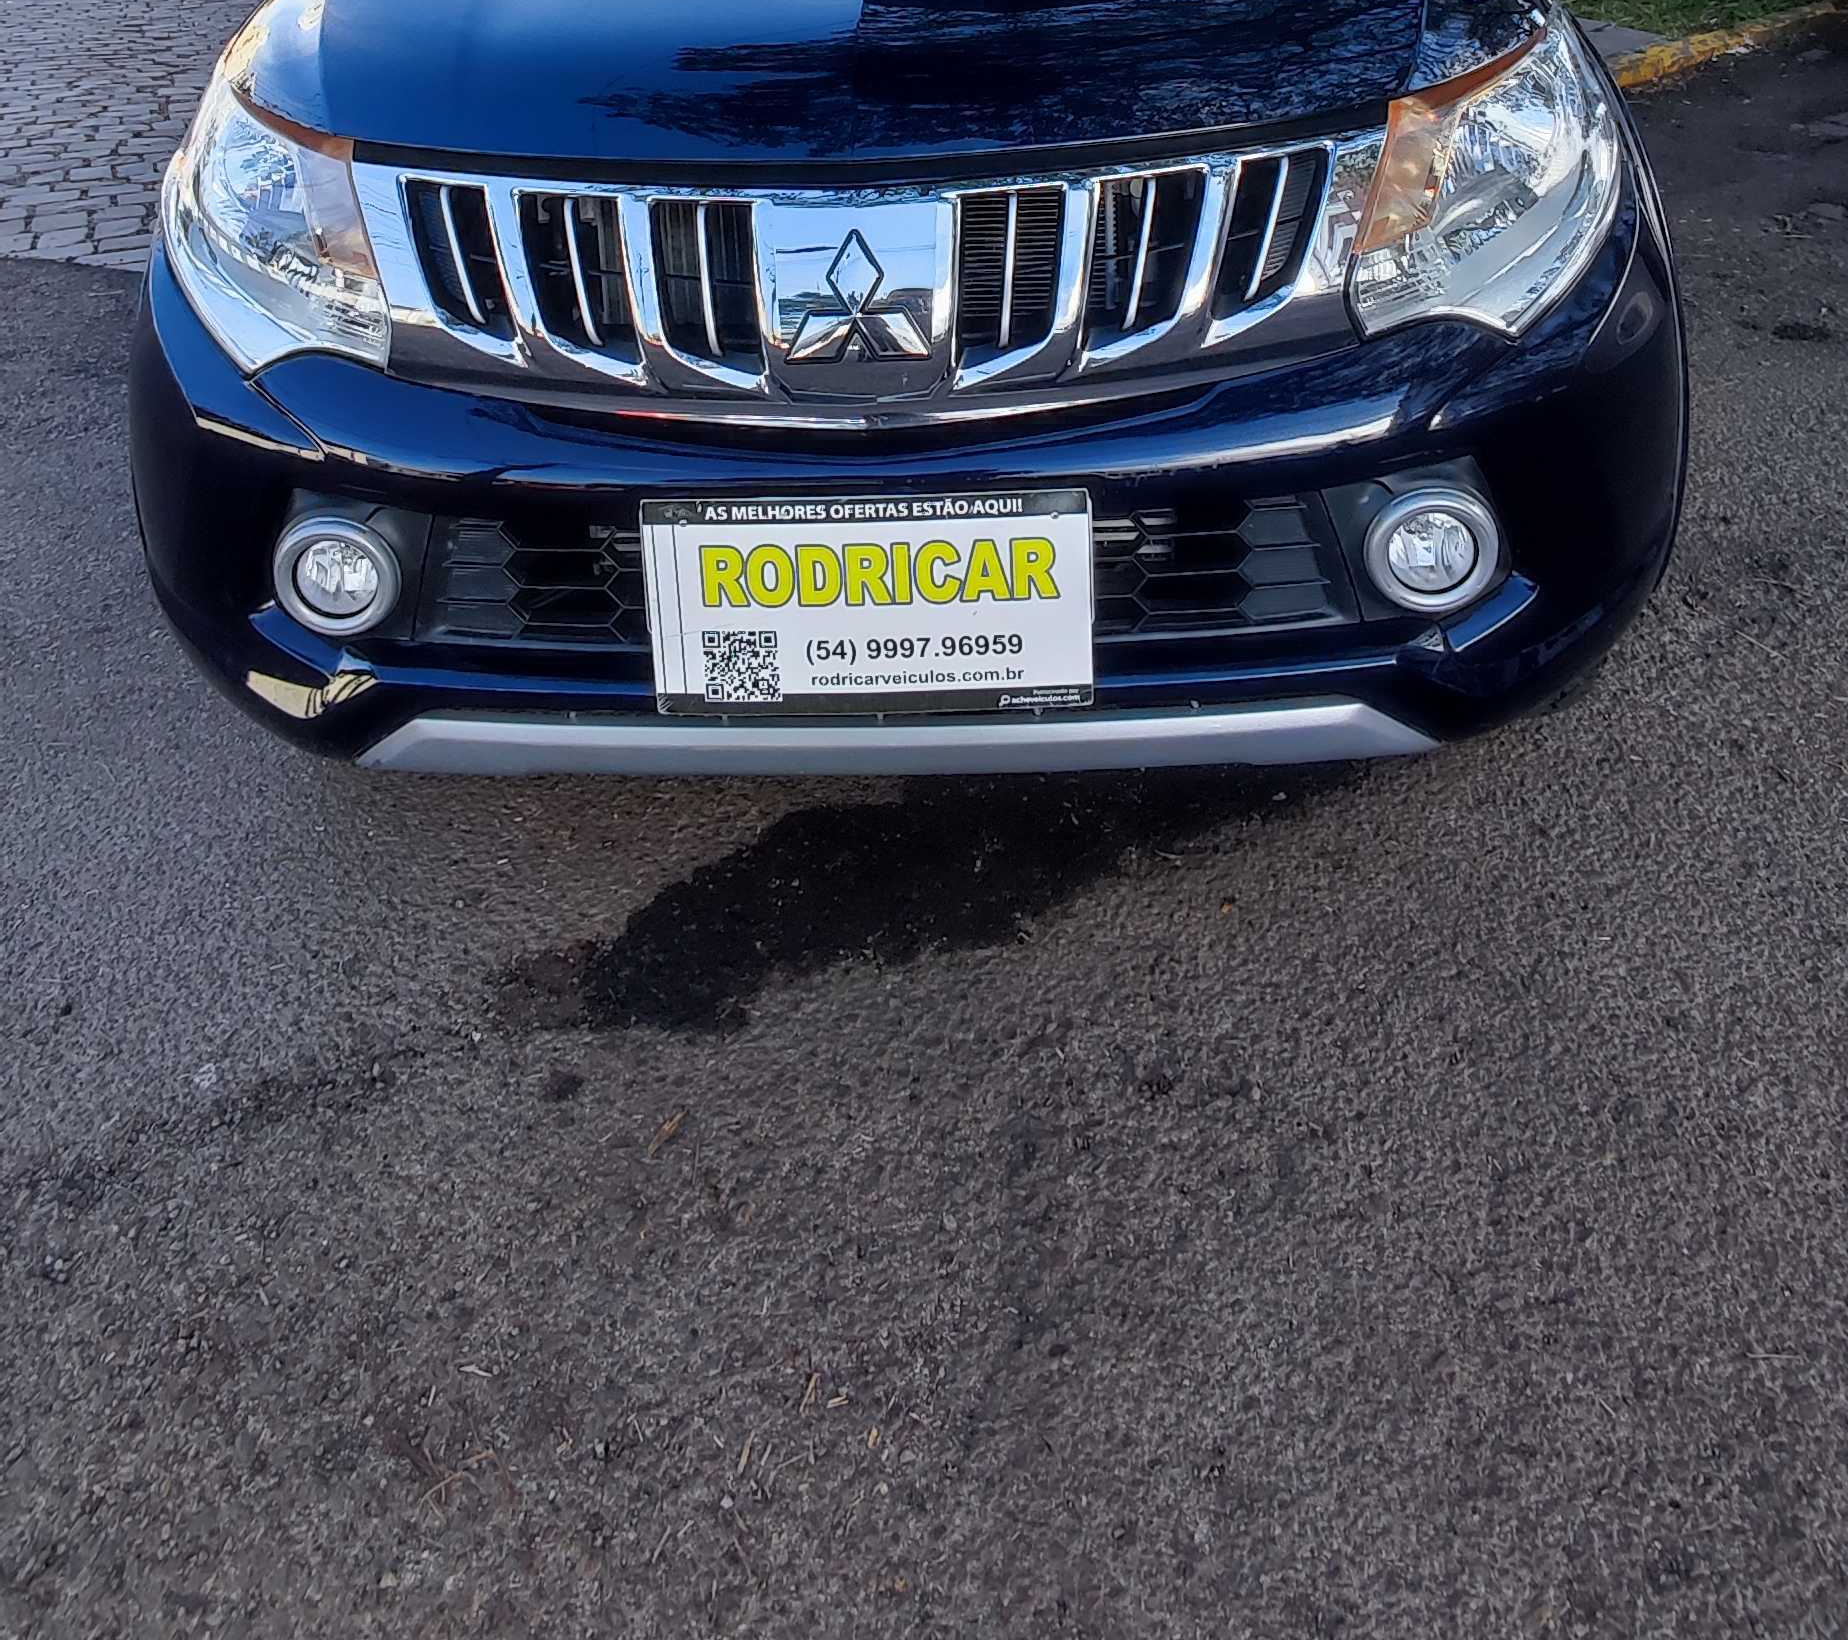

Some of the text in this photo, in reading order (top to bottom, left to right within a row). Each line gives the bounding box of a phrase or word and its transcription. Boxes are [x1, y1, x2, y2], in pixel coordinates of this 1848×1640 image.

[705, 505, 728, 521] AS
[731, 504, 827, 520] MELHORES
[829, 502, 909, 519] OFERTAS
[912, 498, 969, 517] ESTÃO
[699, 537, 1061, 608] RODRICAR
[805, 634, 1024, 665] (54) 9997.96959
[811, 667, 1024, 686] rodricarveiculos.com.br
